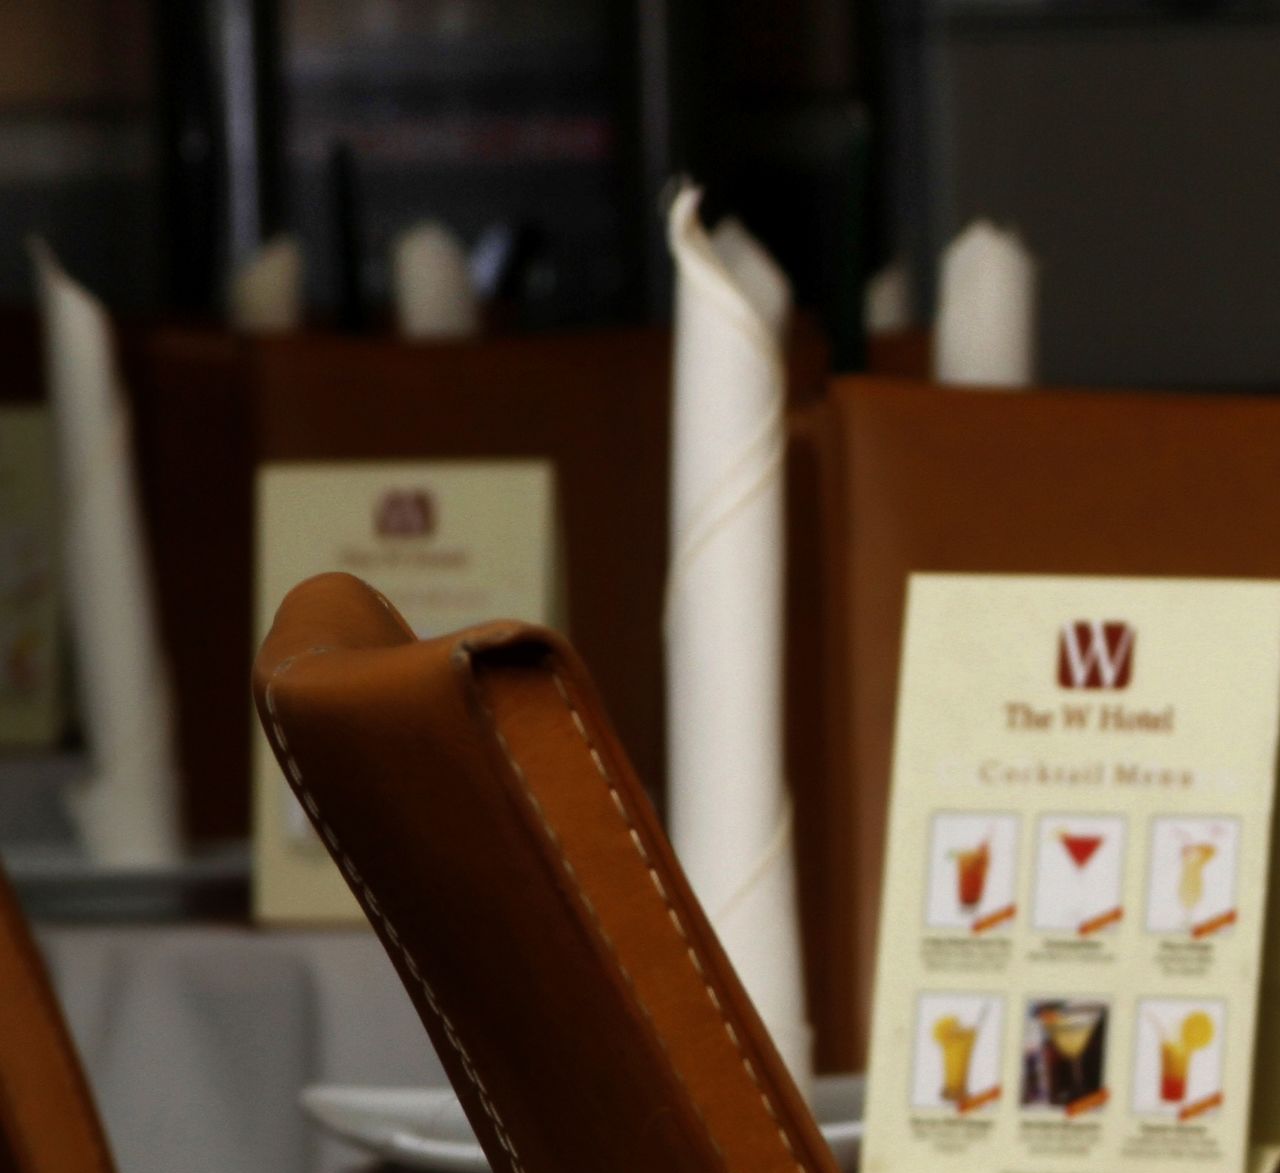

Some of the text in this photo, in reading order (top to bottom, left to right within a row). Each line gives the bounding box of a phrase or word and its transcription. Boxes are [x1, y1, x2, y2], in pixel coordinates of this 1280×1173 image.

[1003, 703, 1174, 733] The W Hotel
[978, 760, 1194, 789] Cocktail Menu
